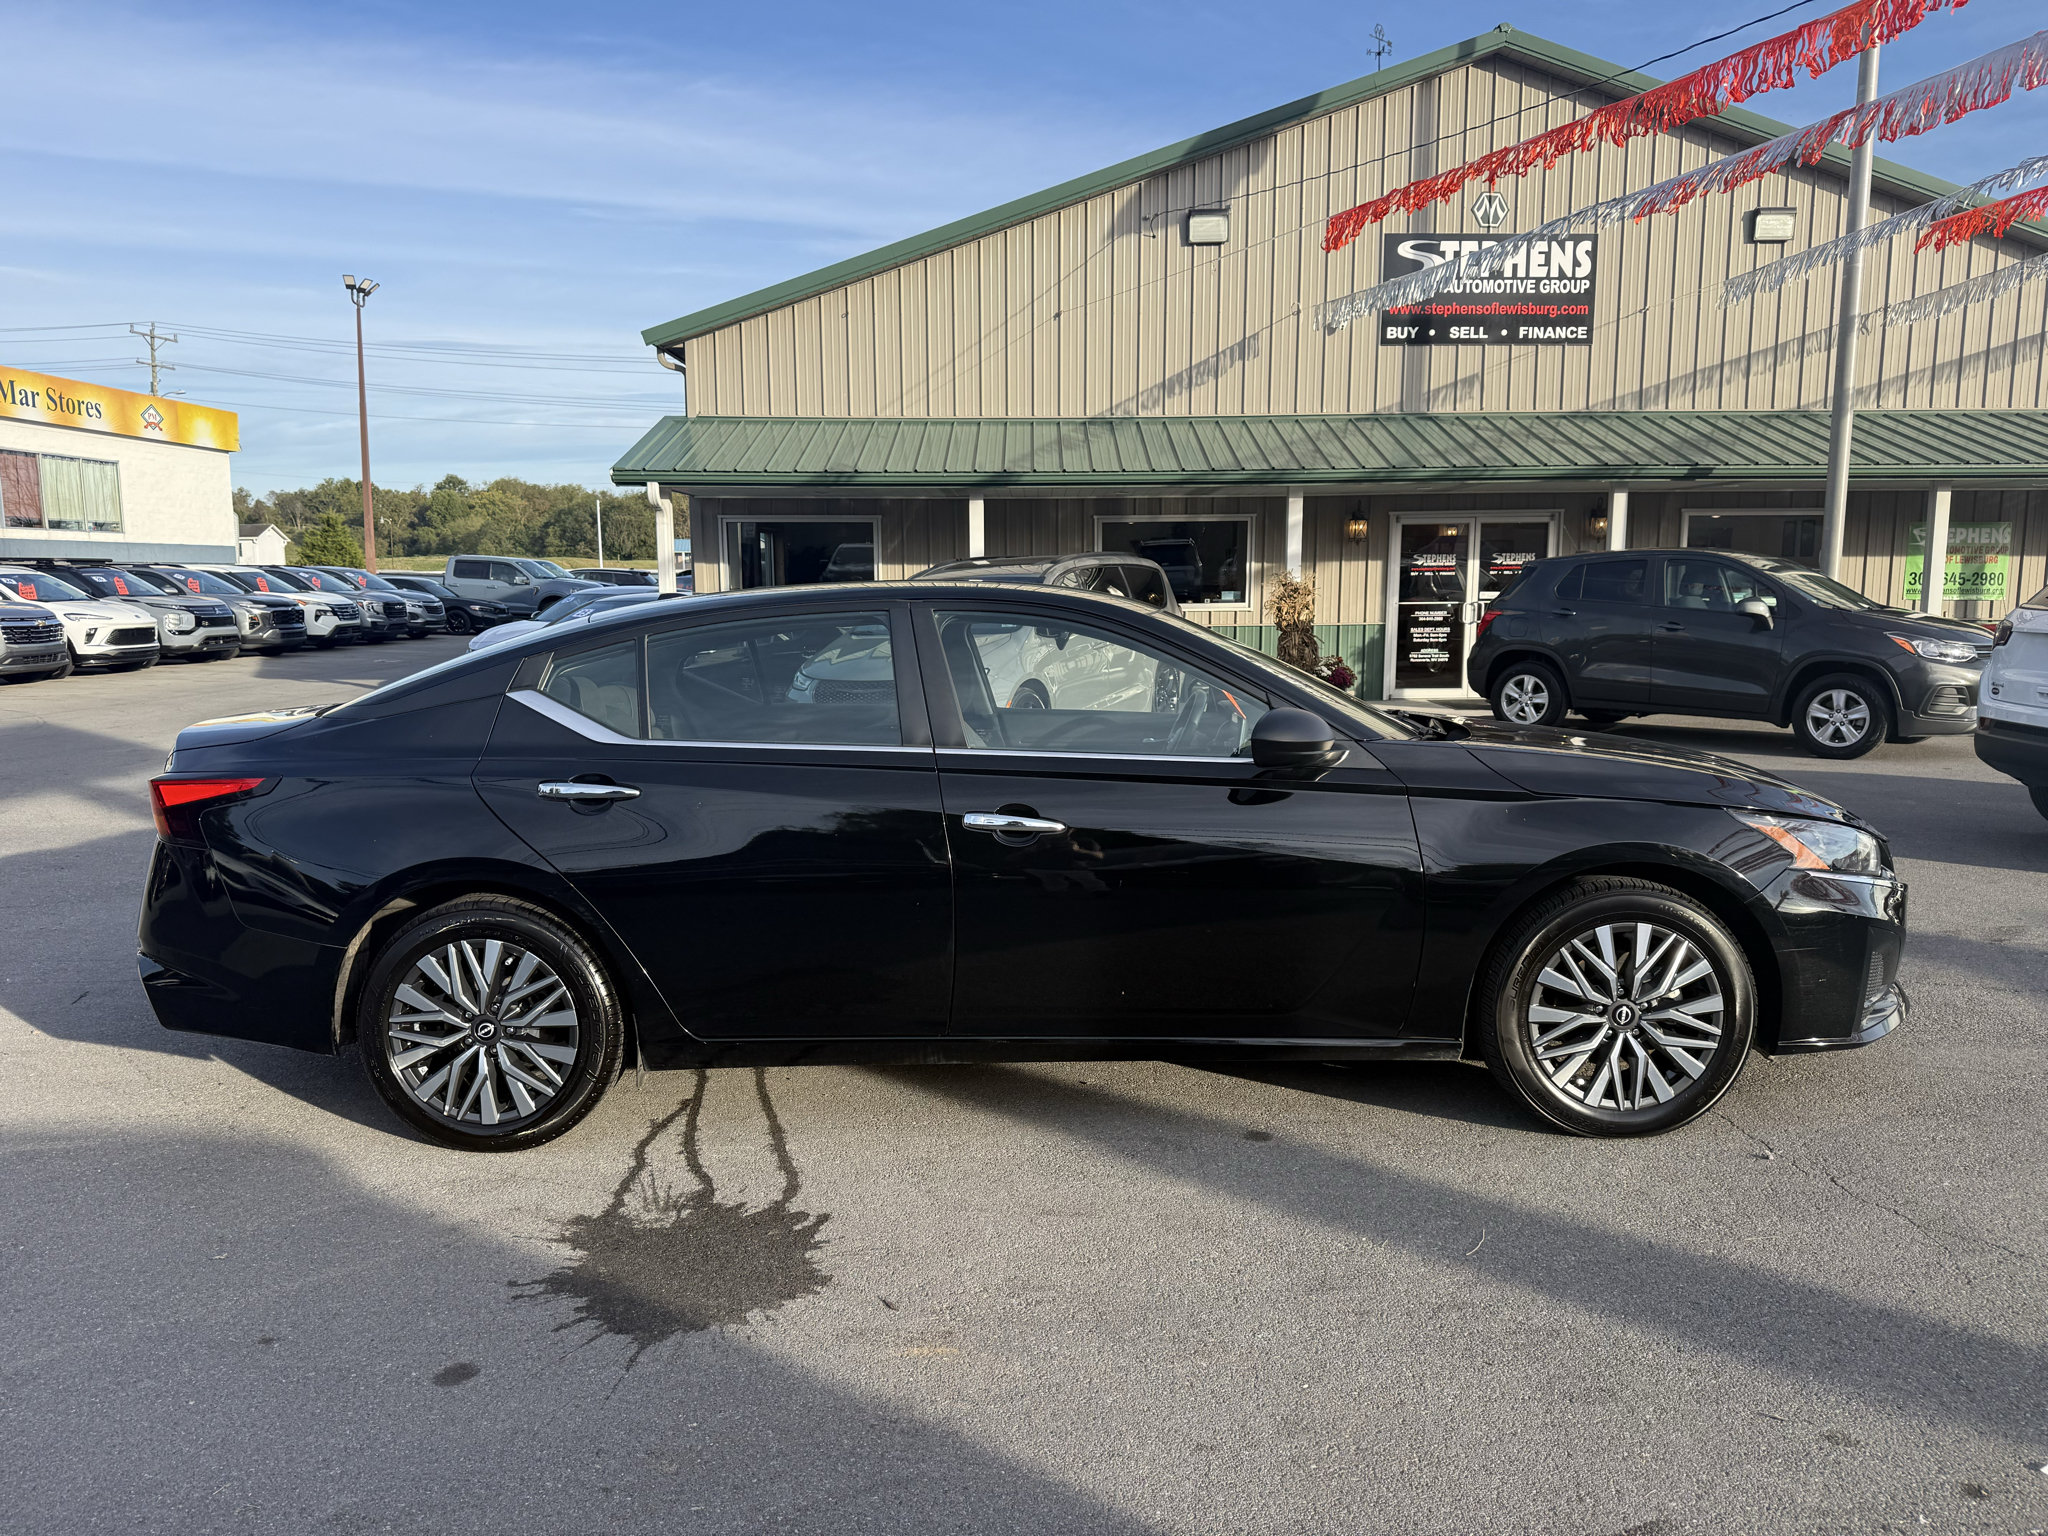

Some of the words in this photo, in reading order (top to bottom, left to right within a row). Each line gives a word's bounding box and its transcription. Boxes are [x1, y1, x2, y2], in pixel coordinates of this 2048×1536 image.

[1397, 240, 1592, 278] STEPHENS
[1444, 279, 1536, 294] AUTOMOTIVE
[1539, 279, 1590, 294] GROUP
[1389, 302, 1589, 318] www.stephensoflewisburg.com
[1386, 326, 1420, 339] BUY
[1449, 326, 1489, 339] SELL
[1518, 326, 1588, 339] FINANCE
[0, 379, 40, 409] Mar
[45, 386, 102, 420] Stores
[1411, 553, 1457, 565] STEPHENS
[1490, 552, 1536, 564] STEPHENS
[1954, 555, 1999, 565] LEWISBURG
